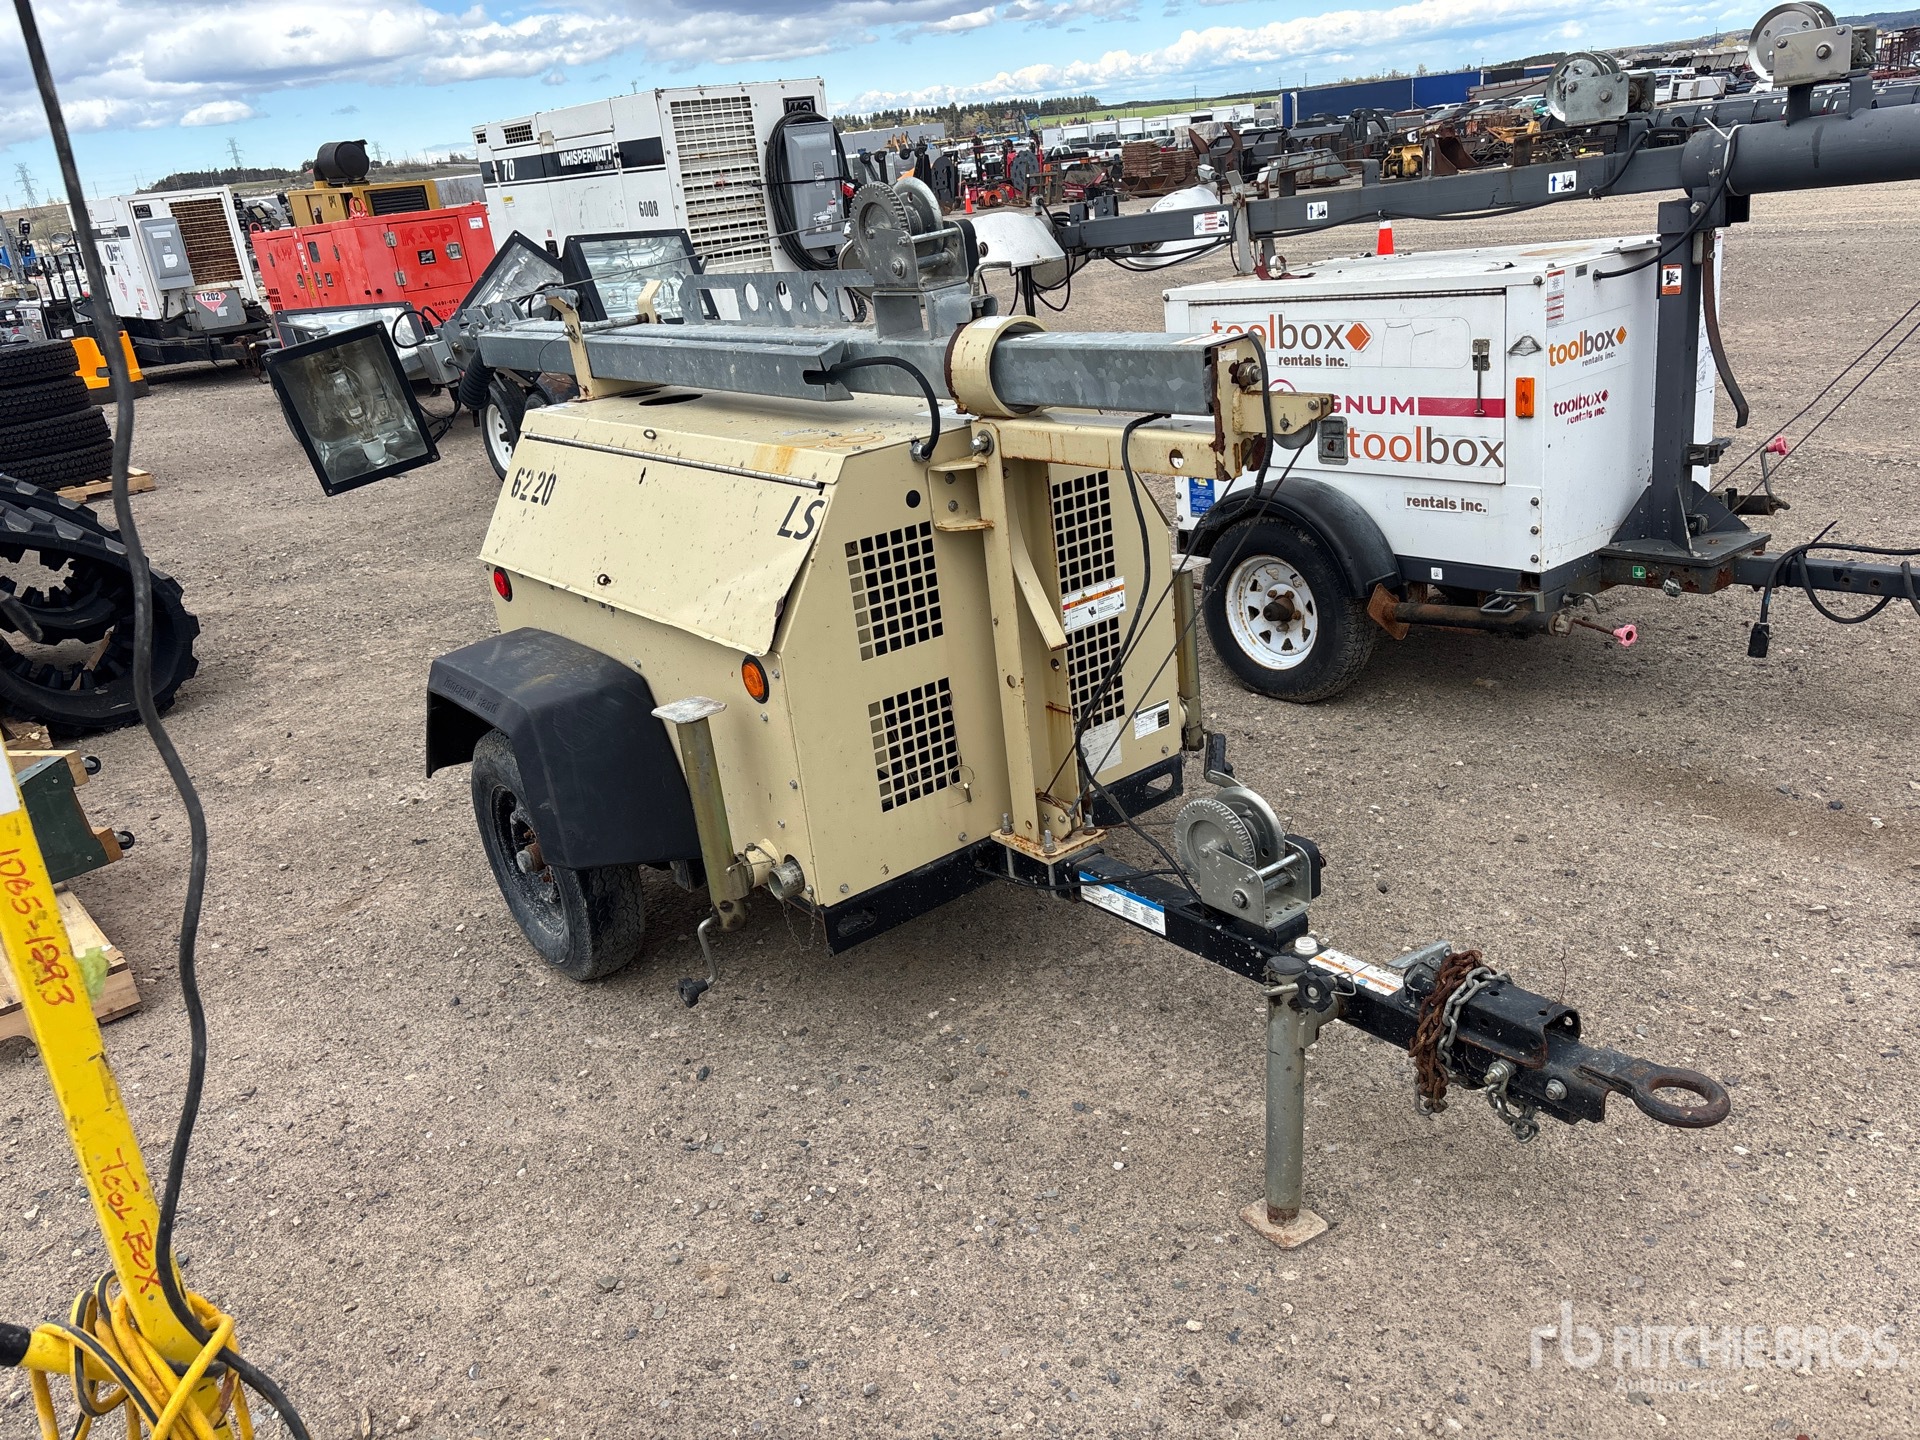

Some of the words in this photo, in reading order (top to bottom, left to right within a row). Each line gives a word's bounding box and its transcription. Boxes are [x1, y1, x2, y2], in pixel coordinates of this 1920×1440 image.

[558, 146, 612, 167] WHISPERWATT
[502, 159, 515, 181] 70
[638, 200, 659, 217] 6008
[202, 292, 220, 302] 1202
[1549, 327, 1616, 367] toolbox
[1278, 354, 1322, 367] rentals
[1325, 354, 1349, 367] inc.
[1582, 354, 1604, 367] rentals
[1605, 351, 1616, 360] inc.
[1553, 391, 1602, 417] toolbox
[1347, 426, 1504, 468] toolbox
[510, 466, 557, 506] 6220
[1406, 496, 1457, 510] rentals
[1461, 498, 1487, 513] inc.
[777, 495, 826, 540] LS
